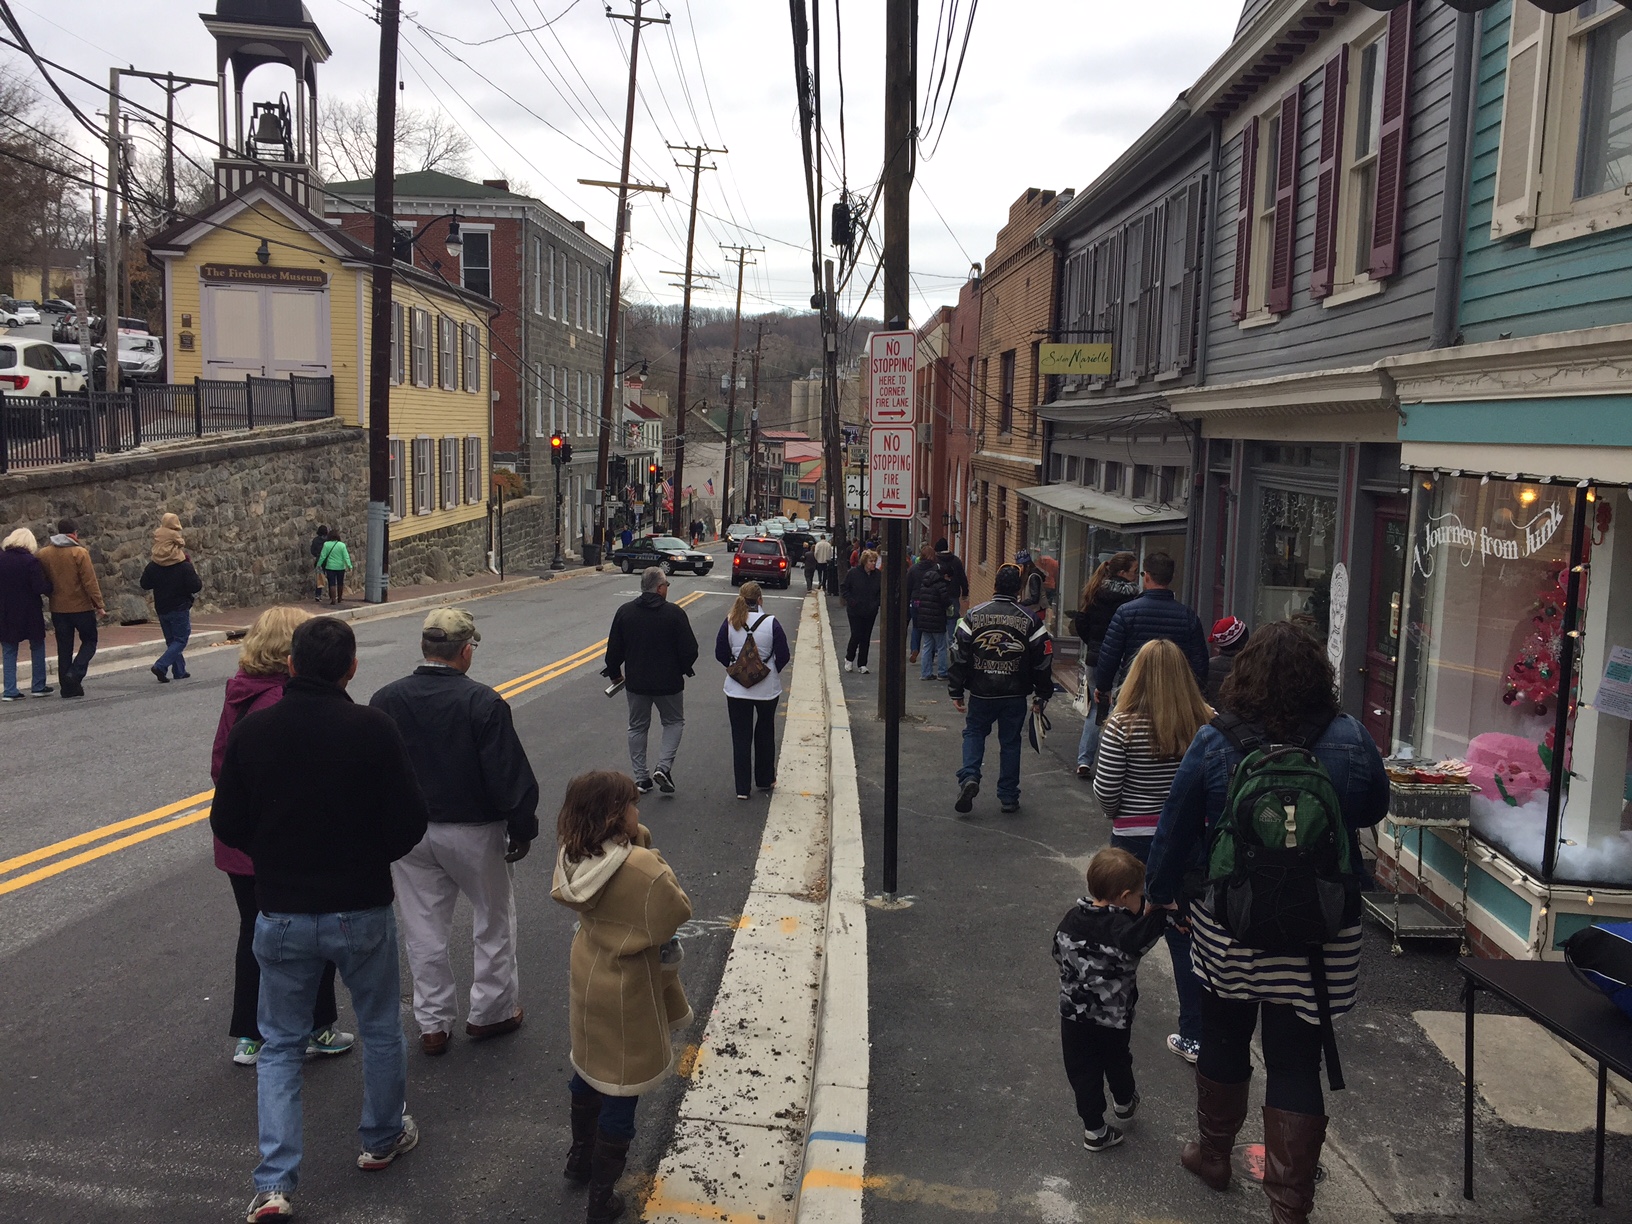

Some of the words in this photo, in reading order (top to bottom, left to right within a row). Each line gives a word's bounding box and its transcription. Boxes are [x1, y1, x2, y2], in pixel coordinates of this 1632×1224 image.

[205, 267, 225, 277] The
[228, 268, 277, 280] Firehouse
[280, 271, 322, 282] Museum
[886, 341, 900, 356] NO
[873, 357, 913, 374] STOPPING
[1068, 349, 1109, 369] Marielle
[879, 376, 896, 386] HERE
[899, 375, 907, 385] TO
[879, 387, 906, 397] CORNER
[875, 398, 890, 408] FIRE
[892, 398, 909, 408] LANE
[884, 435, 900, 451] NO
[873, 454, 911, 471] STOPPING
[883, 473, 899, 486] FIRE
[882, 487, 900, 500] LANE
[1421, 510, 1477, 567] Journey
[1480, 526, 1519, 567] from
[1510, 500, 1564, 557] Junk
[972, 614, 1029, 636] BALTIMORE
[973, 653, 1021, 671] RAVENS
